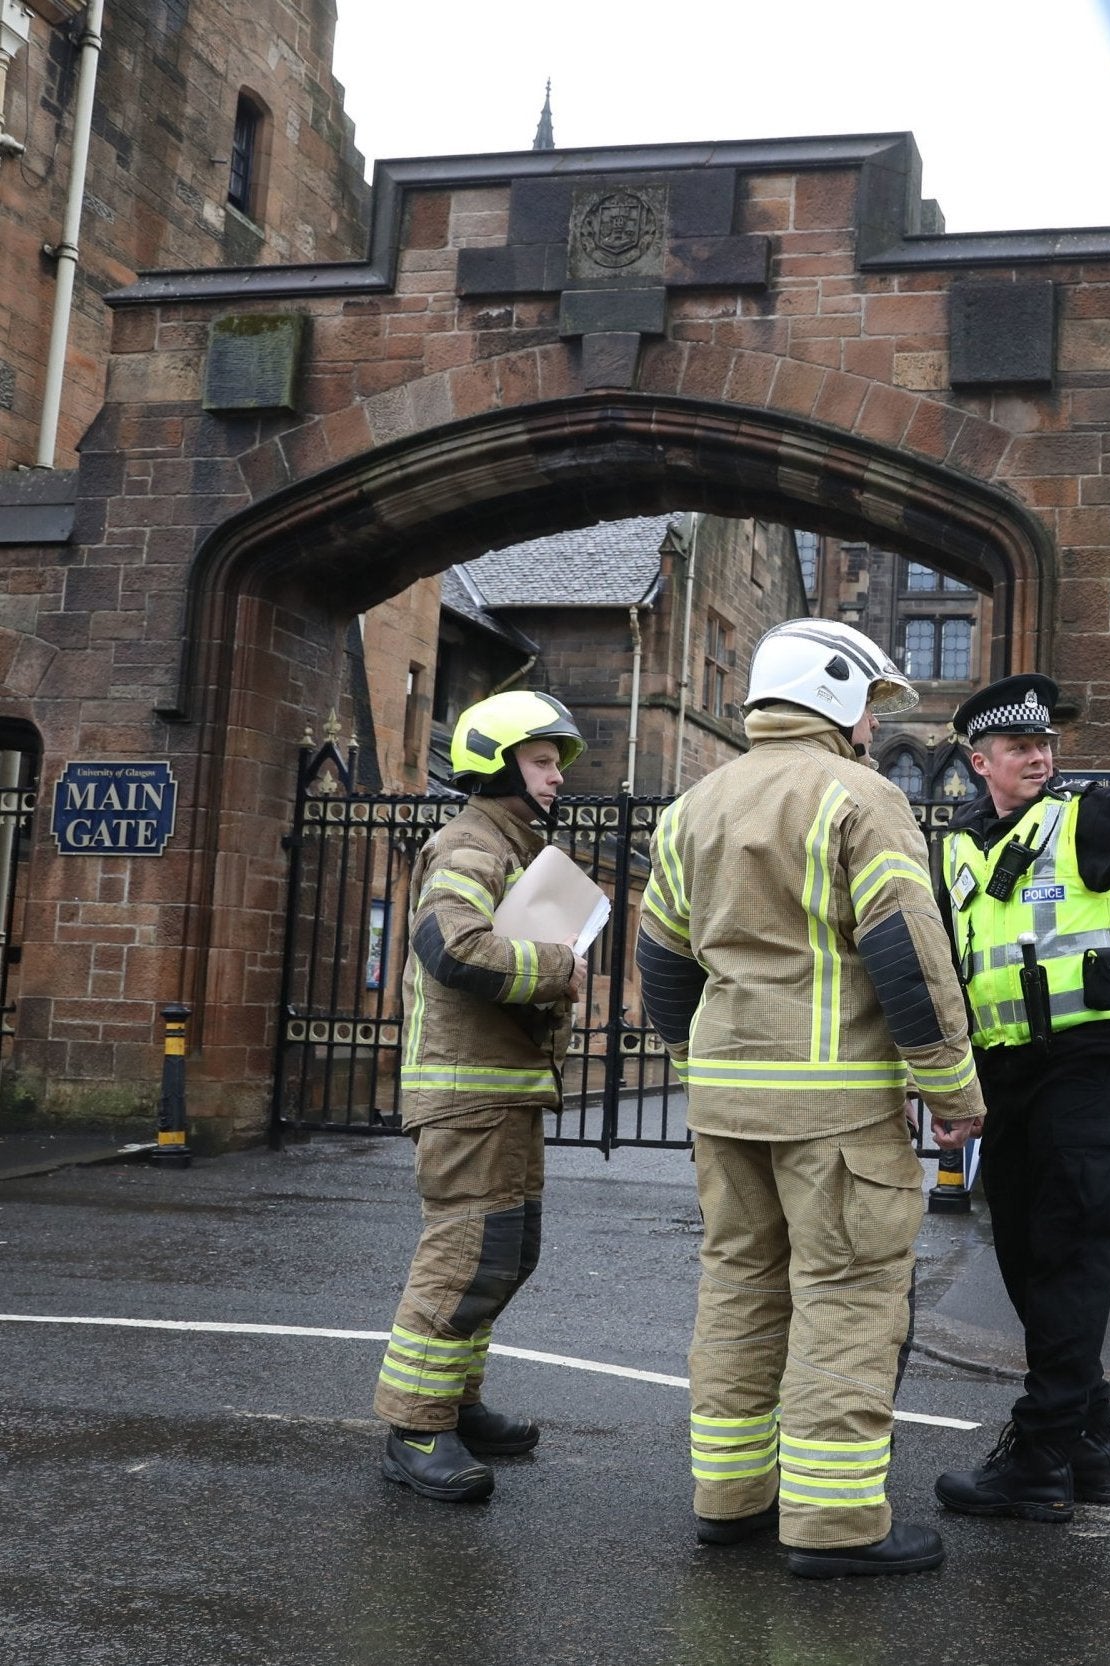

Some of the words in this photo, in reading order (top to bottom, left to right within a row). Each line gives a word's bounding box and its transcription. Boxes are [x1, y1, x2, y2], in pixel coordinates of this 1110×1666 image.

[77, 768, 114, 778] University
[115, 769, 125, 779] of
[125, 768, 156, 779] Glasgow
[64, 782, 166, 811] MAIN
[65, 818, 158, 848] GATE
[1023, 887, 1063, 901] POLICE
